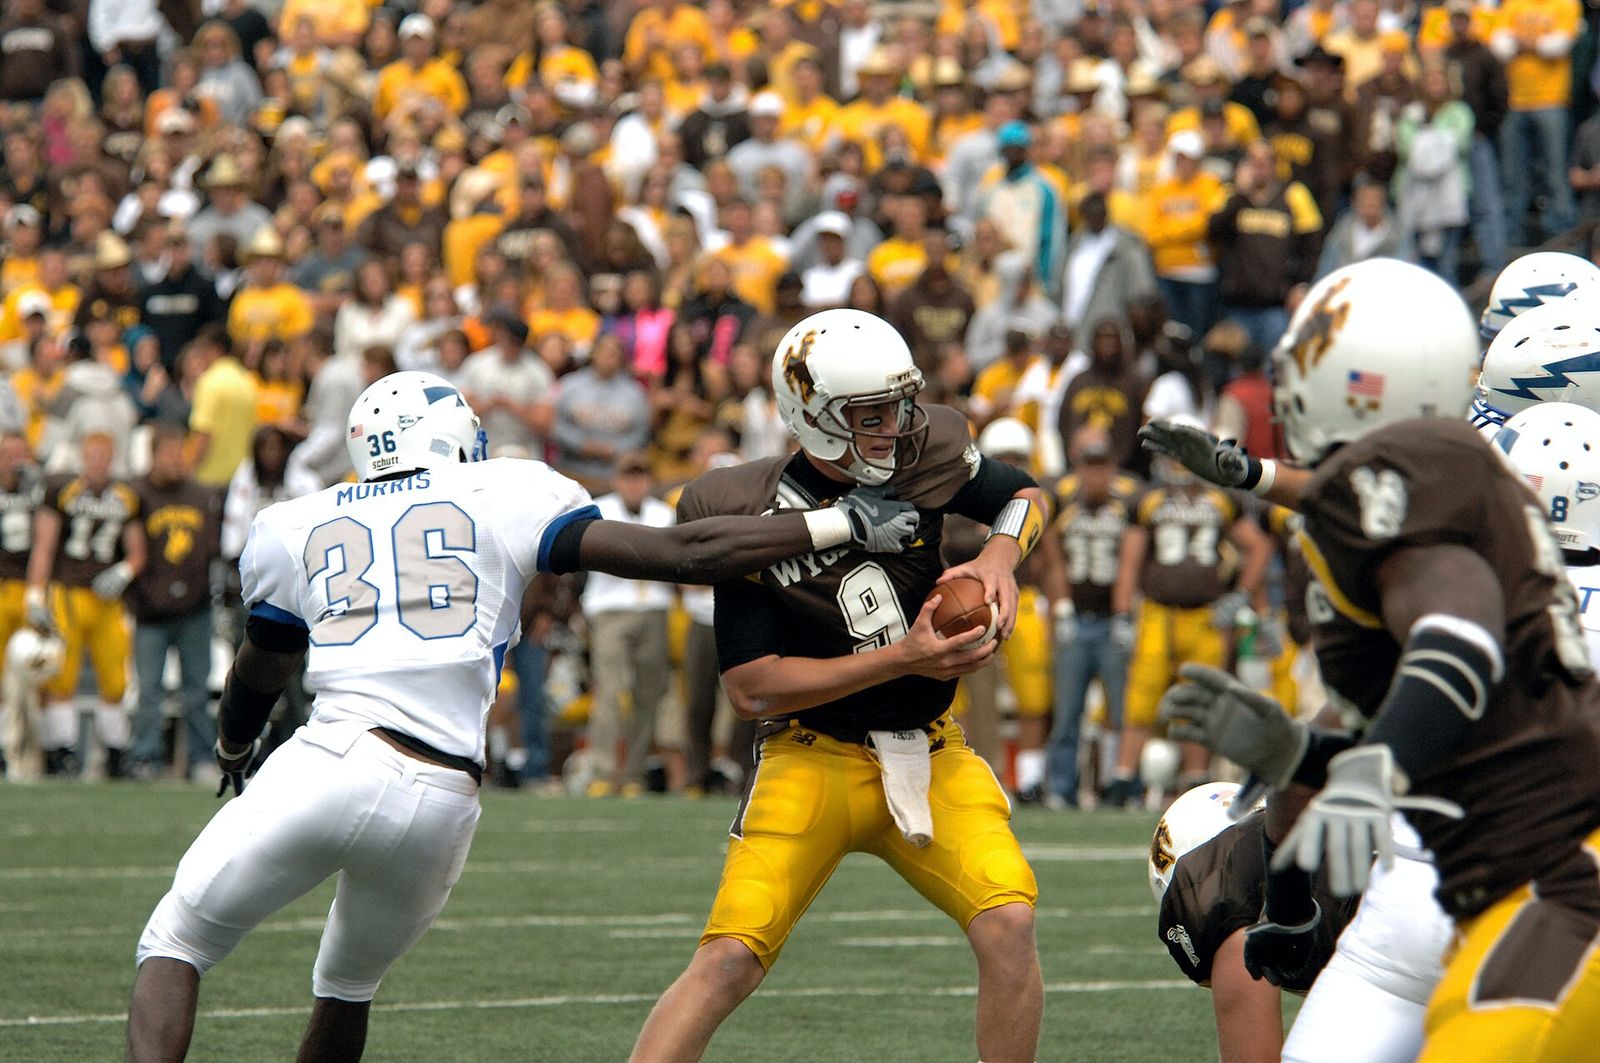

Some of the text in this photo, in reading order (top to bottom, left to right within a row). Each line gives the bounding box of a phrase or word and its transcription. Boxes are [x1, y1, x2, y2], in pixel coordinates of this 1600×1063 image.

[366, 430, 397, 457] 36
[372, 456, 399, 469] schutt
[336, 471, 431, 506] MORRIS
[1551, 495, 1569, 522] 8
[303, 501, 479, 647] 36
[836, 560, 910, 655] 9
